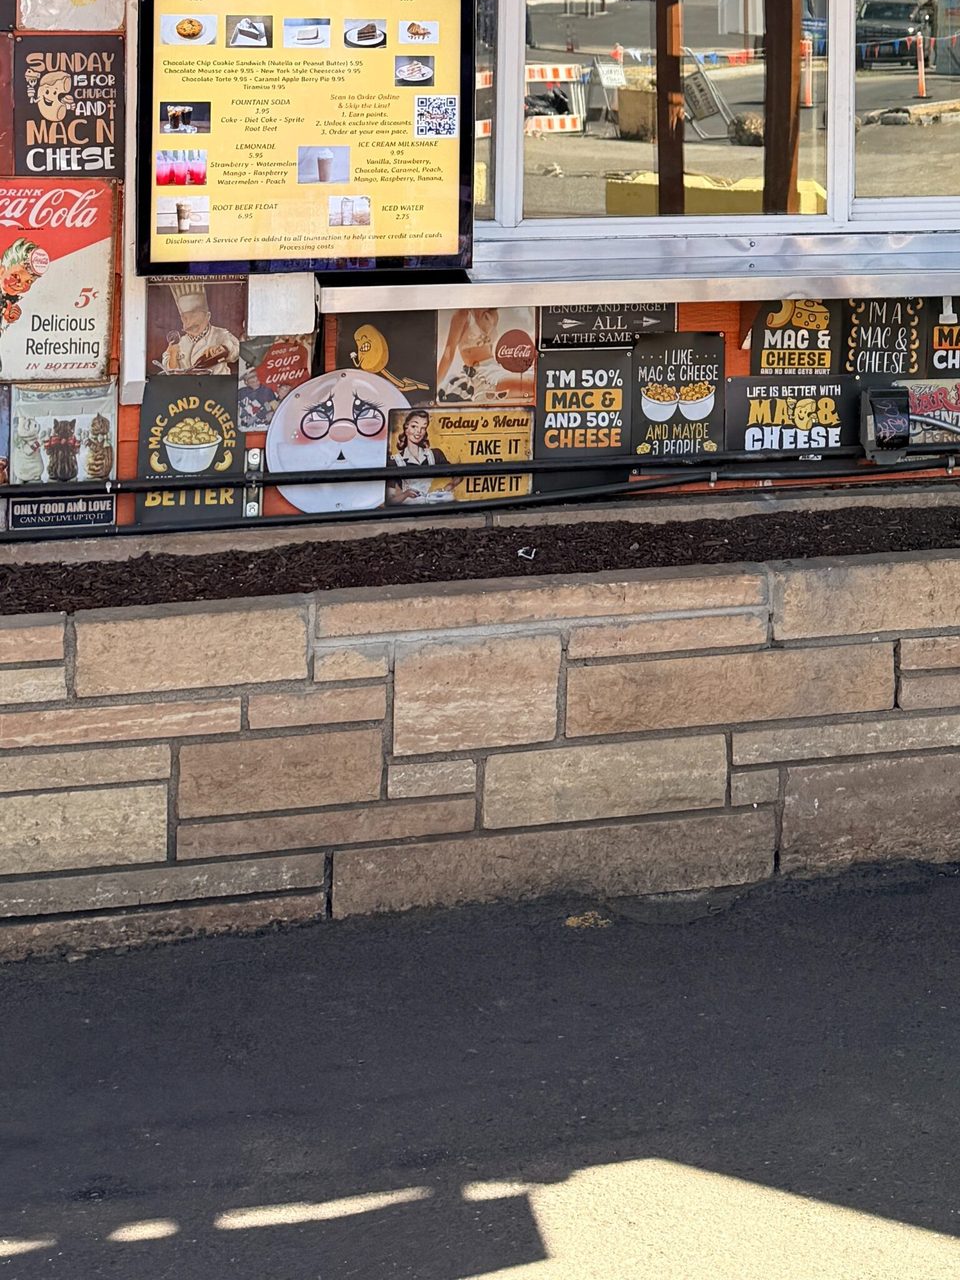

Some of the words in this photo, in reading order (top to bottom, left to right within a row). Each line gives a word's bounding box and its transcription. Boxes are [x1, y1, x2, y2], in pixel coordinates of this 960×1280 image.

[26, 53, 114, 72] SUNDAY
[74, 76, 86, 86] IS
[90, 75, 115, 86] FOR
[74, 89, 116, 99] CHURCH
[76, 102, 106, 116] AND
[26, 120, 88, 146] MAC
[96, 120, 115, 143] N
[26, 148, 115, 171] CHEESE
[32, 315, 95, 332] Delicious
[26, 338, 99, 358] Refreshing
[546, 370, 576, 388] I'M
[582, 370, 623, 387] 50%
[551, 392, 594, 409] MAC
[600, 391, 615, 407] &
[439, 416, 488, 431] Today's
[493, 416, 529, 428] Menu
[545, 413, 581, 428] AND
[587, 412, 622, 427] 50%
[545, 429, 621, 448] CHEESE
[469, 440, 501, 456] TAKE
[509, 439, 520, 454] IT
